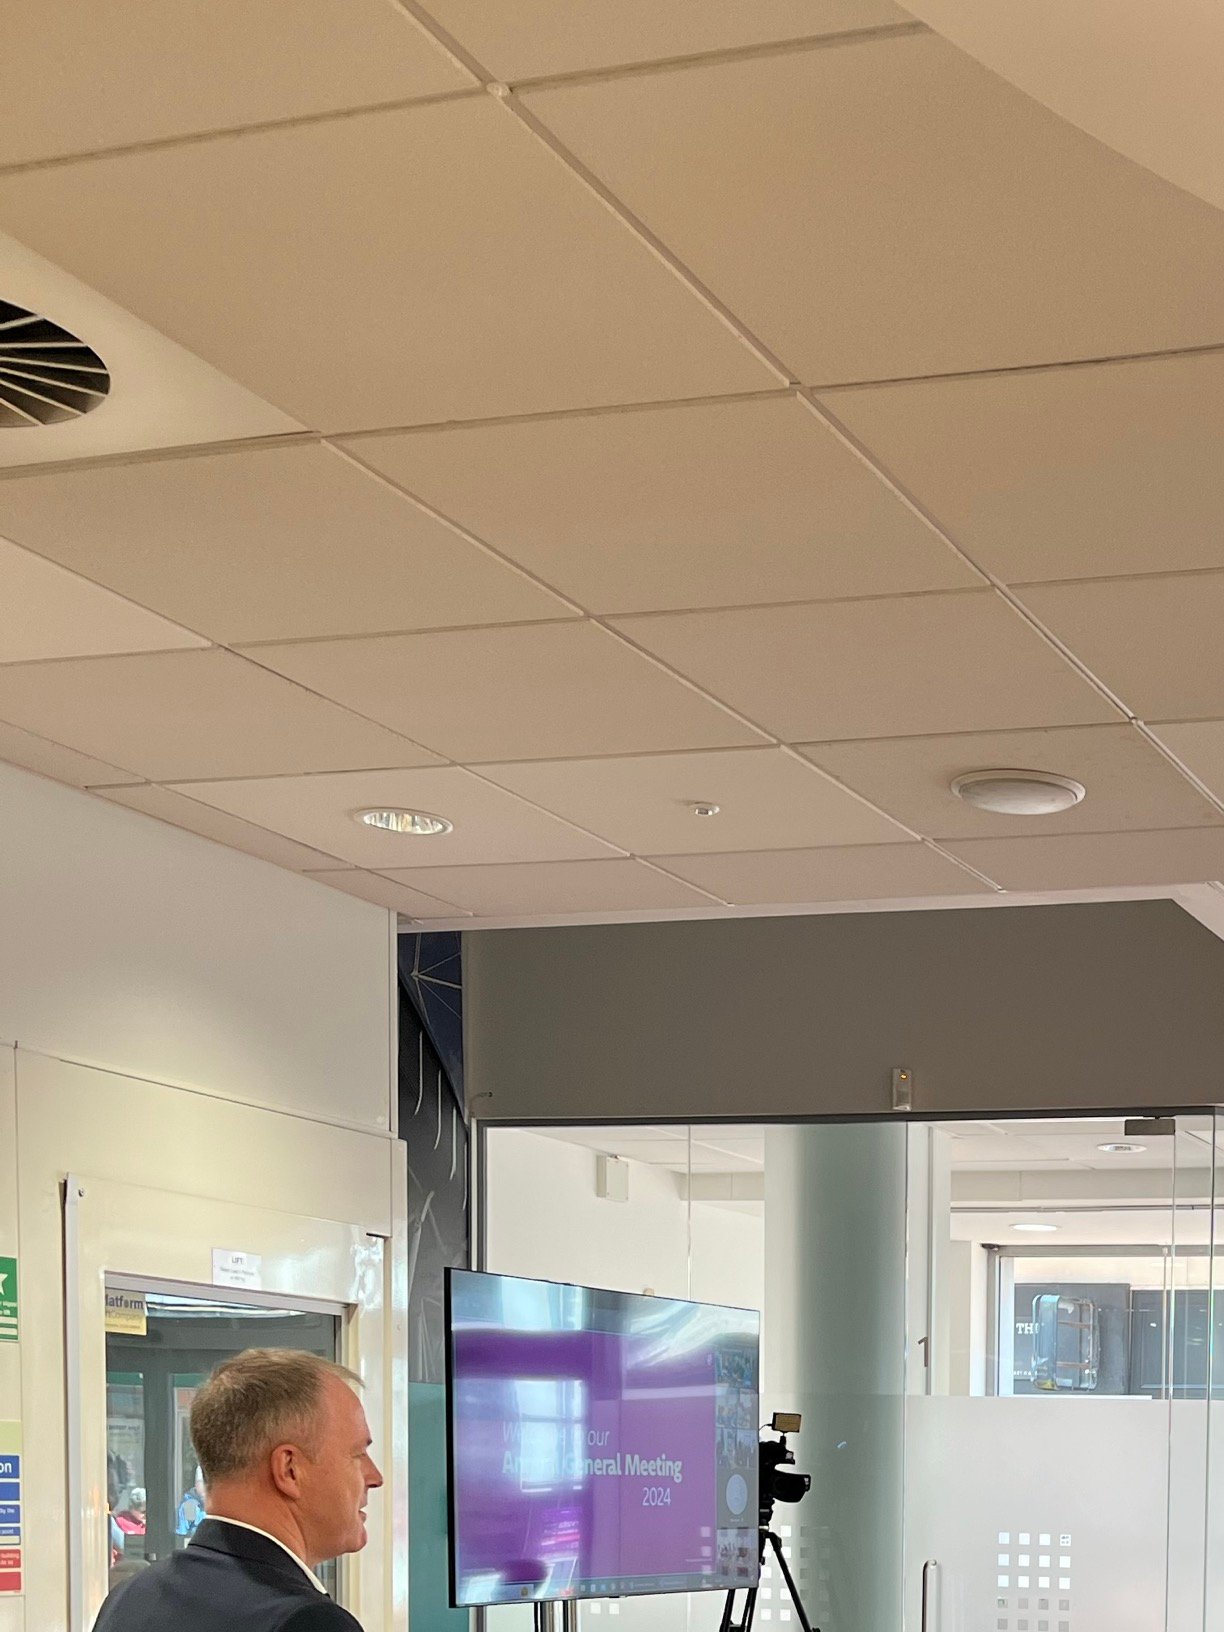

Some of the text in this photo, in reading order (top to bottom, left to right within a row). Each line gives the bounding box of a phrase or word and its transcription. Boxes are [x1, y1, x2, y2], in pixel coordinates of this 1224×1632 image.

[588, 1430, 610, 1447] our
[625, 1453, 683, 1484] Meeting
[642, 1486, 672, 1506] 2024
